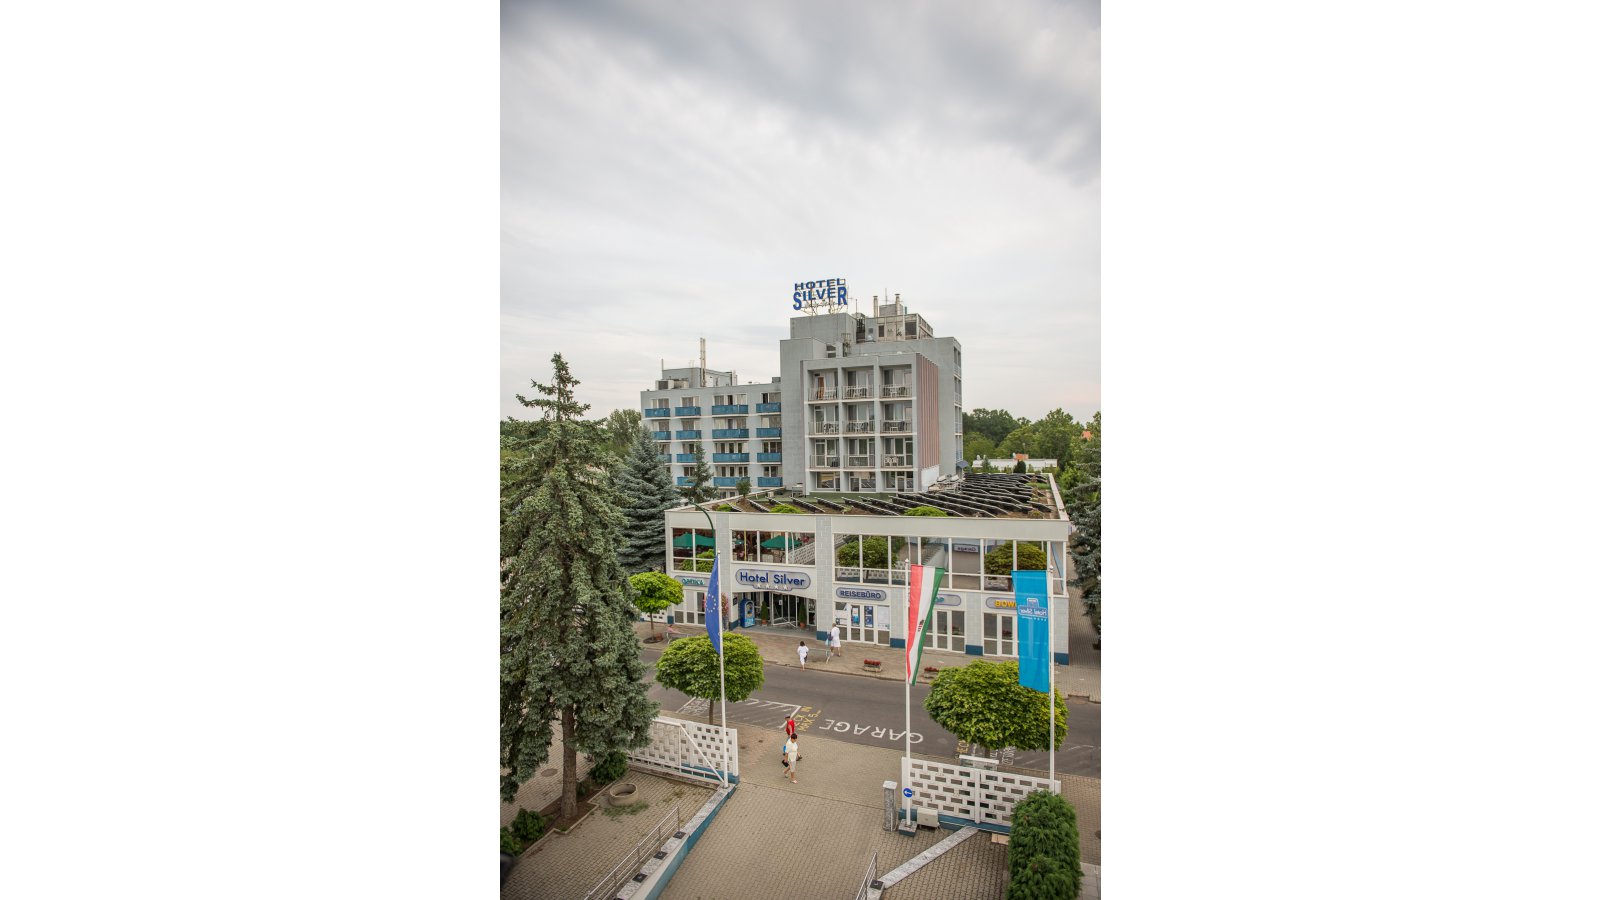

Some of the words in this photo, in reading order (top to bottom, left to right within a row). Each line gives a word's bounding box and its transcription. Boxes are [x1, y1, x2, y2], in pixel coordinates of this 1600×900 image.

[794, 278, 846, 291] HOTEL
[793, 286, 848, 310] SILVER
[740, 572, 769, 583] Hotel
[773, 572, 805, 586] Silver
[840, 590, 881, 599] REISEBÜRO
[819, 719, 924, 744] GARAGE
